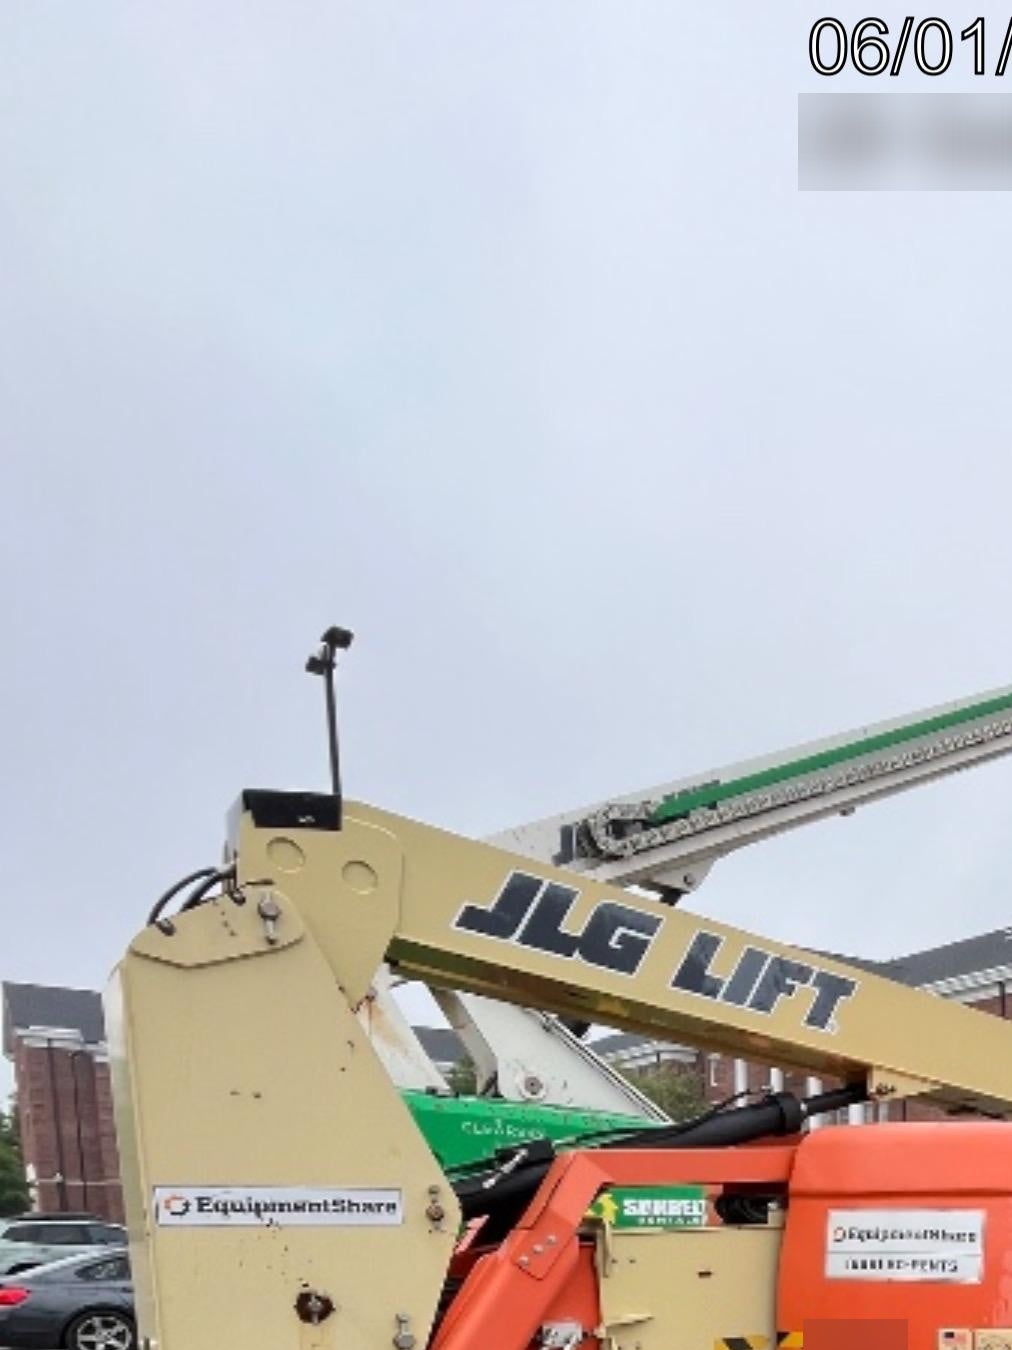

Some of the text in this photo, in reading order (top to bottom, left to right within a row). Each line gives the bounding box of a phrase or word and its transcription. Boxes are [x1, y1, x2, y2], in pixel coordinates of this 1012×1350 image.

[451, 869, 861, 1034] JLG LIFT
[195, 1196, 397, 1216] EquipmentShare
